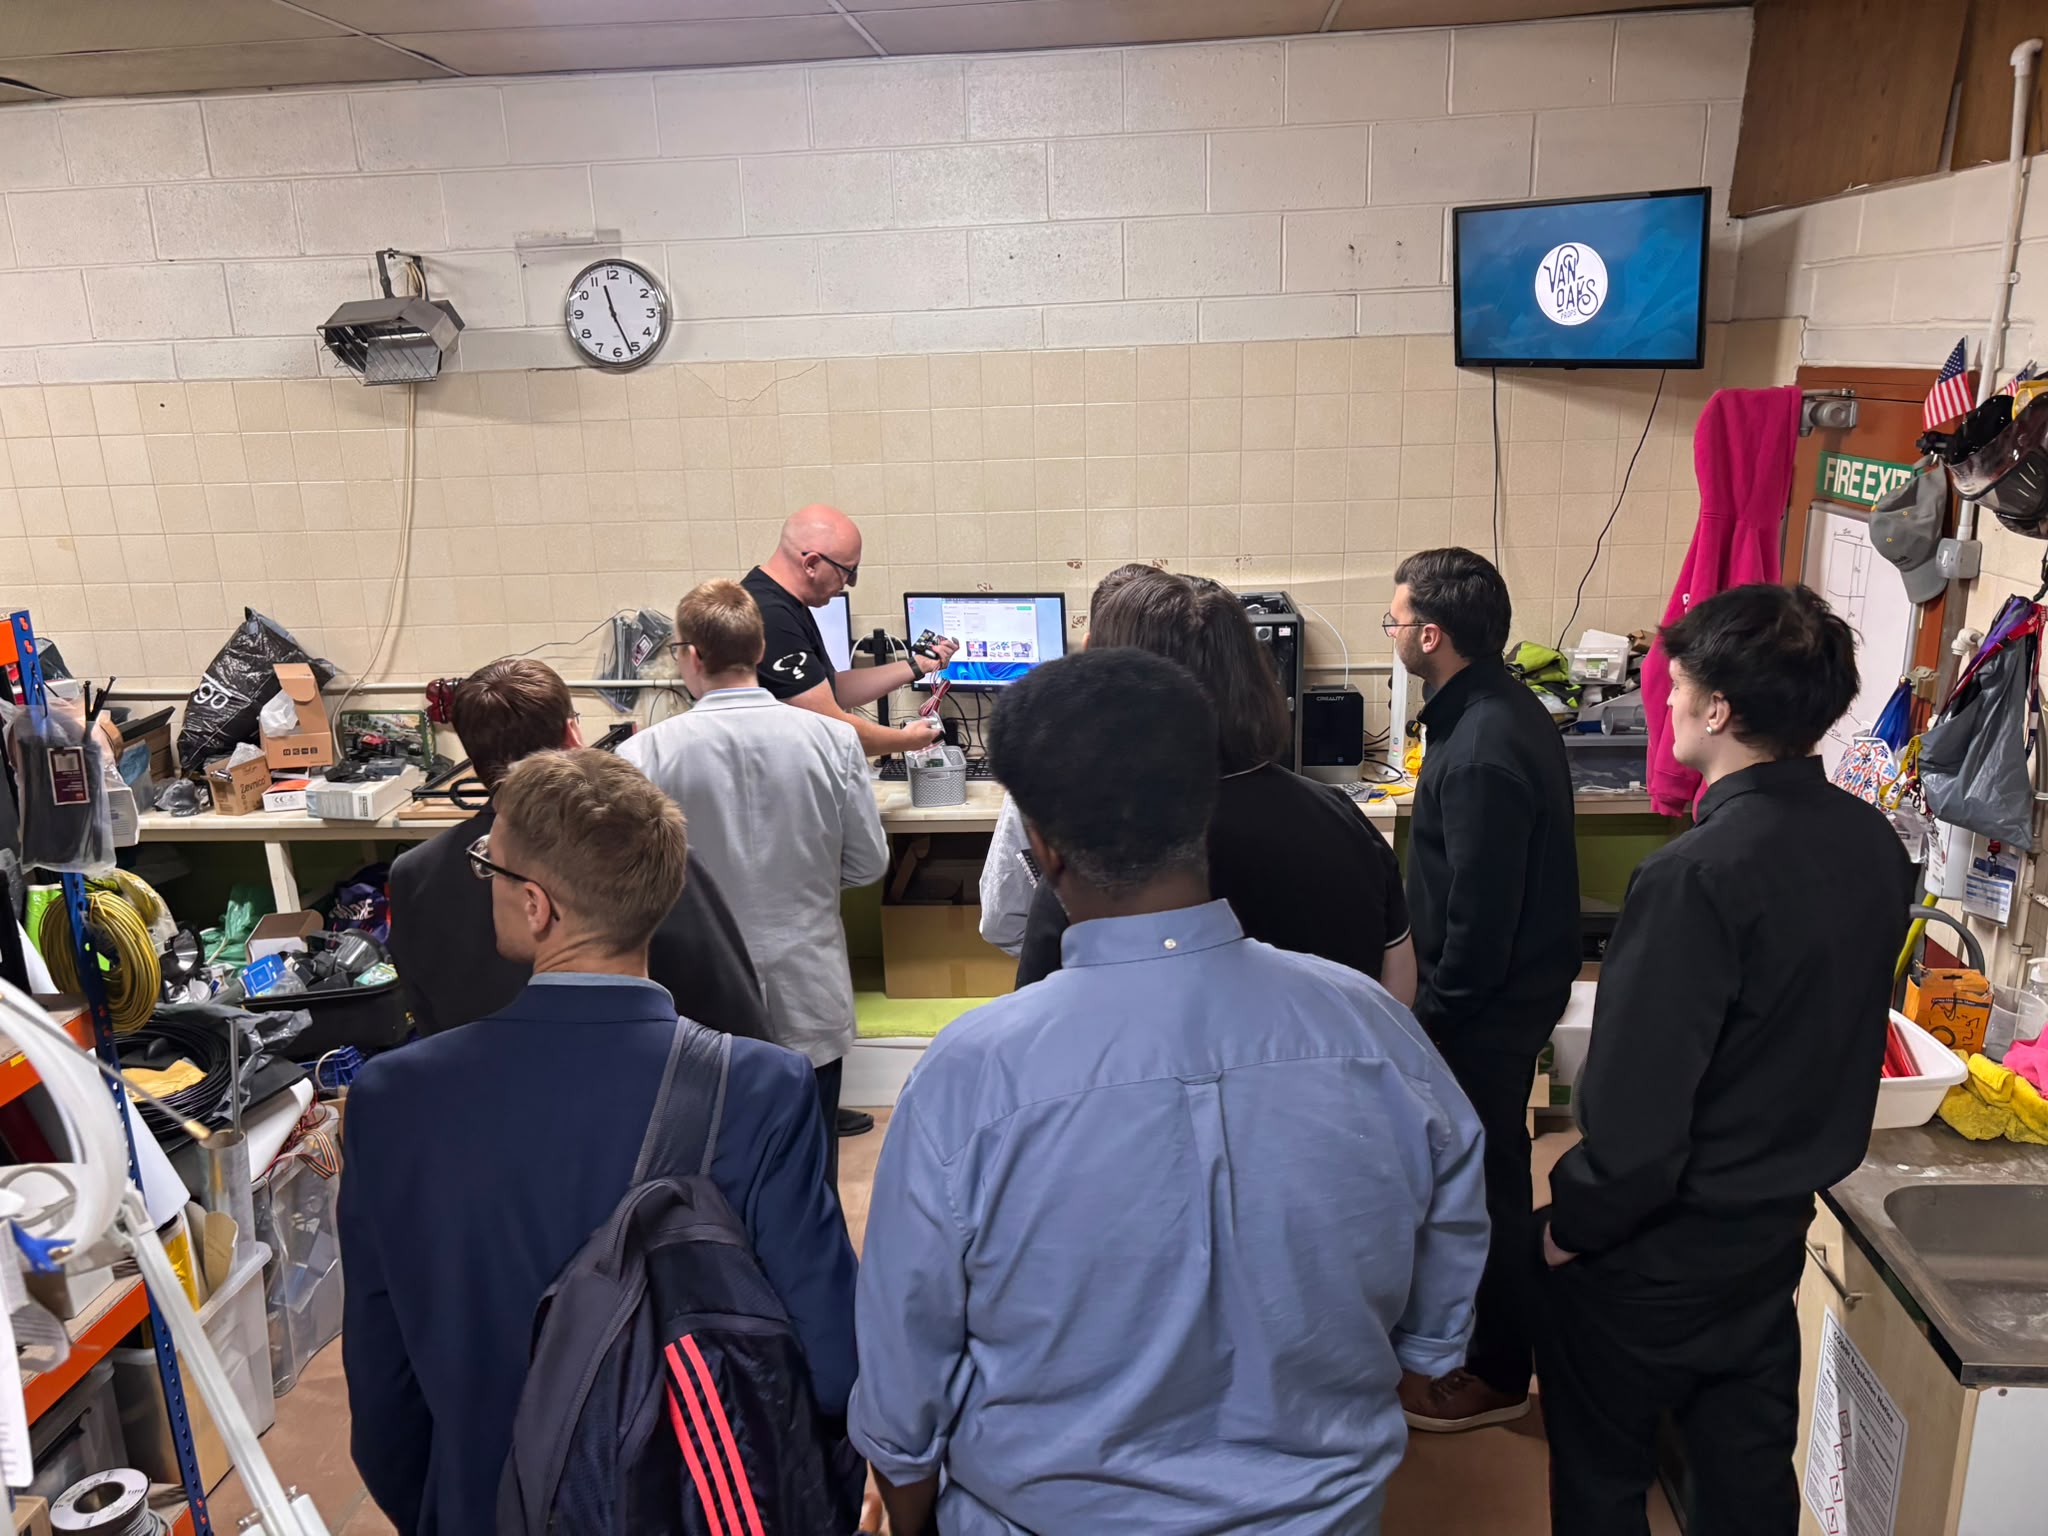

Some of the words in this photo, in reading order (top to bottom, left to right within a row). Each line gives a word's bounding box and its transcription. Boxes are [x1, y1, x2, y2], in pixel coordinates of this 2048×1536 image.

[1543, 245, 1579, 293] VAN
[606, 270, 619, 280] 12
[629, 274, 632, 284] 1
[591, 277, 598, 287] 11
[579, 291, 589, 300] 10
[640, 288, 649, 299] 2
[1557, 275, 1598, 316] OAKS
[574, 310, 584, 319] 9
[646, 308, 656, 318] 3
[581, 329, 592, 338] 8
[642, 327, 652, 337] 4
[595, 343, 604, 353] 7
[631, 341, 641, 352] 5
[613, 347, 623, 357] 6
[1824, 457, 1864, 498] FIRE
[1861, 464, 1911, 502] EXIT
